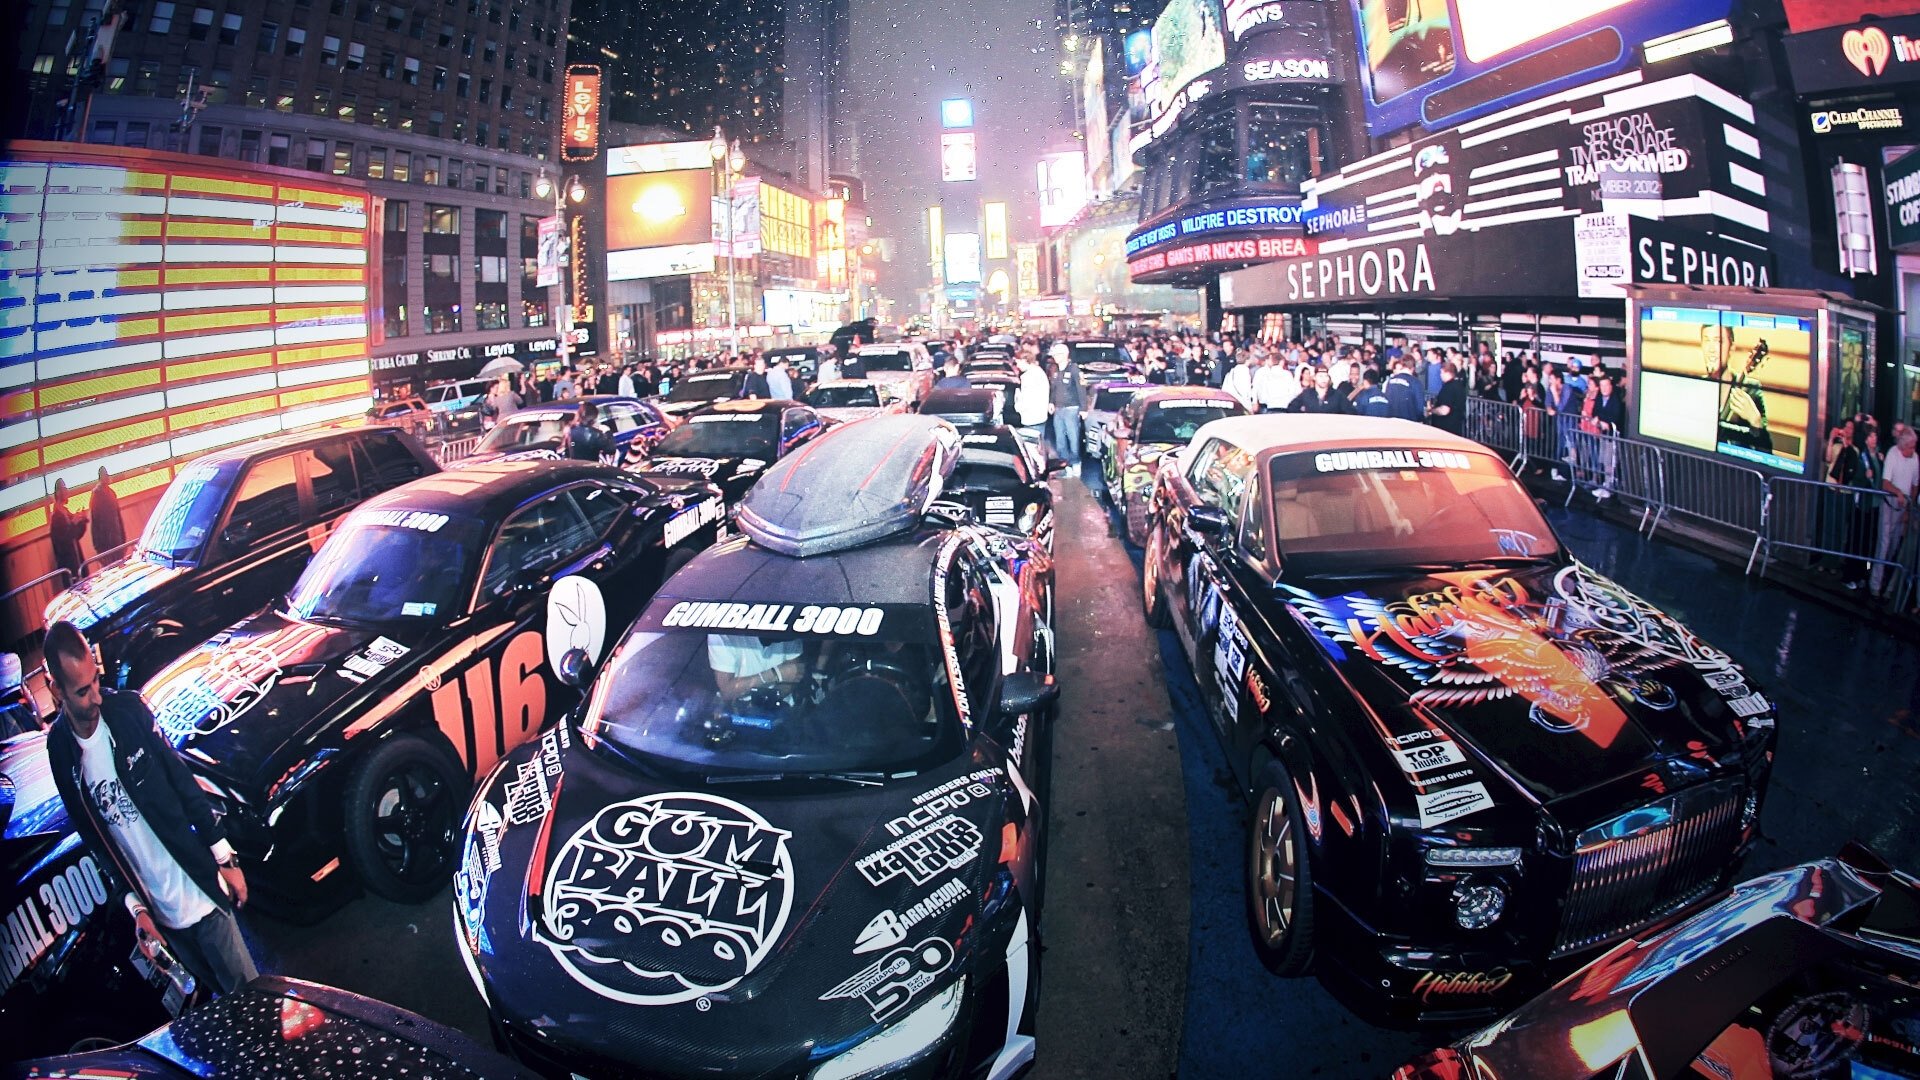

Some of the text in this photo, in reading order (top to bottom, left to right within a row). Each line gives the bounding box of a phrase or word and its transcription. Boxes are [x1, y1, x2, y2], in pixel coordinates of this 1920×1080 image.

[1244, 59, 1329, 80] SEASON
[1583, 113, 1655, 145] SEPHORA
[1569, 128, 1677, 166] TIMES SQUARE
[1887, 170, 1920, 205] STARB
[1181, 211, 1225, 234] WILDFIRE
[1227, 206, 1303, 226] DESTROY
[1307, 206, 1357, 234] SEPHORA
[1587, 215, 1616, 228] PALACE
[1167, 246, 1194, 267] GIANTS
[1212, 240, 1256, 259] NICKS
[1258, 238, 1306, 258] BREA
[1638, 237, 1770, 287] SEPHORA
[1286, 243, 1436, 301] SEPHORA
[1315, 449, 1472, 473] GUMBALL 3000
[661, 601, 884, 636] GUMBALL 3000
[431, 631, 547, 782] 116
[1404, 745, 1445, 763] TOP
[1410, 755, 1452, 770] TRUMPS
[912, 775, 970, 806] MEMBERS
[884, 790, 971, 837] INCIPIO
[39, 856, 109, 935] 3000
[554, 841, 770, 946] BALL
[872, 878, 968, 944] BARRACUDA
[548, 902, 753, 990] 3000
[852, 959, 906, 997] INDIANAPOLIS
[870, 936, 955, 1023] 500
[911, 975, 933, 993] 2012
